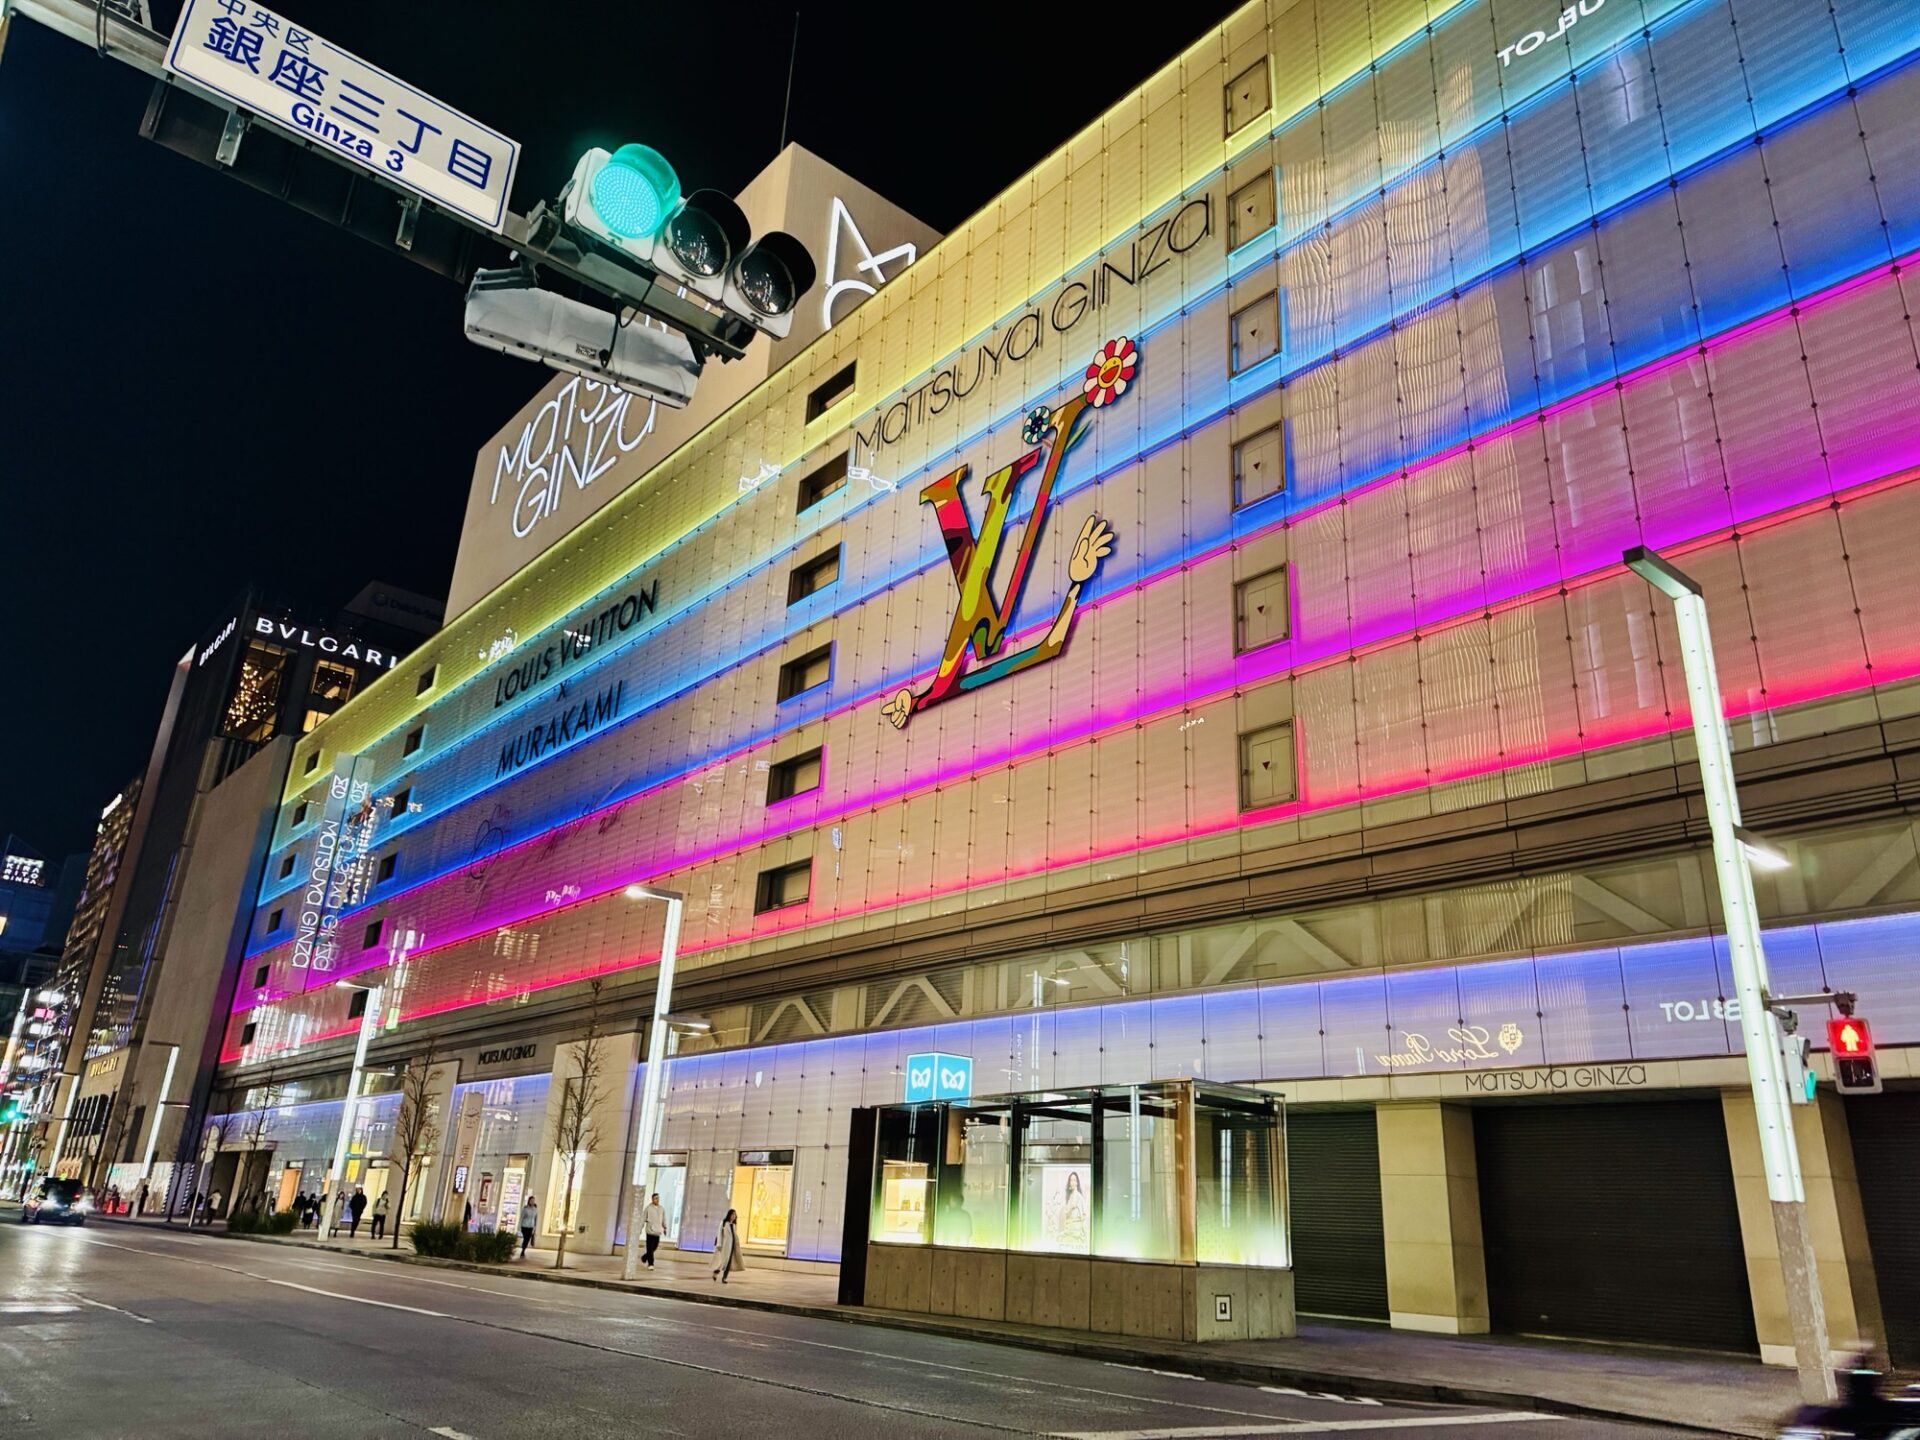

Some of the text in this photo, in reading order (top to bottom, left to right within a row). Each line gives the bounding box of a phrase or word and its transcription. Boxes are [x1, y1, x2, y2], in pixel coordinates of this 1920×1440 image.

[216, 0, 313, 54] 中央区
[203, 17, 492, 190] 銀座三丁目
[291, 102, 405, 173] Ginza 3
[255, 616, 397, 669] BVLGARI
[494, 579, 658, 709] LOUIS VUITTON
[495, 679, 623, 779] MURAKAMI
